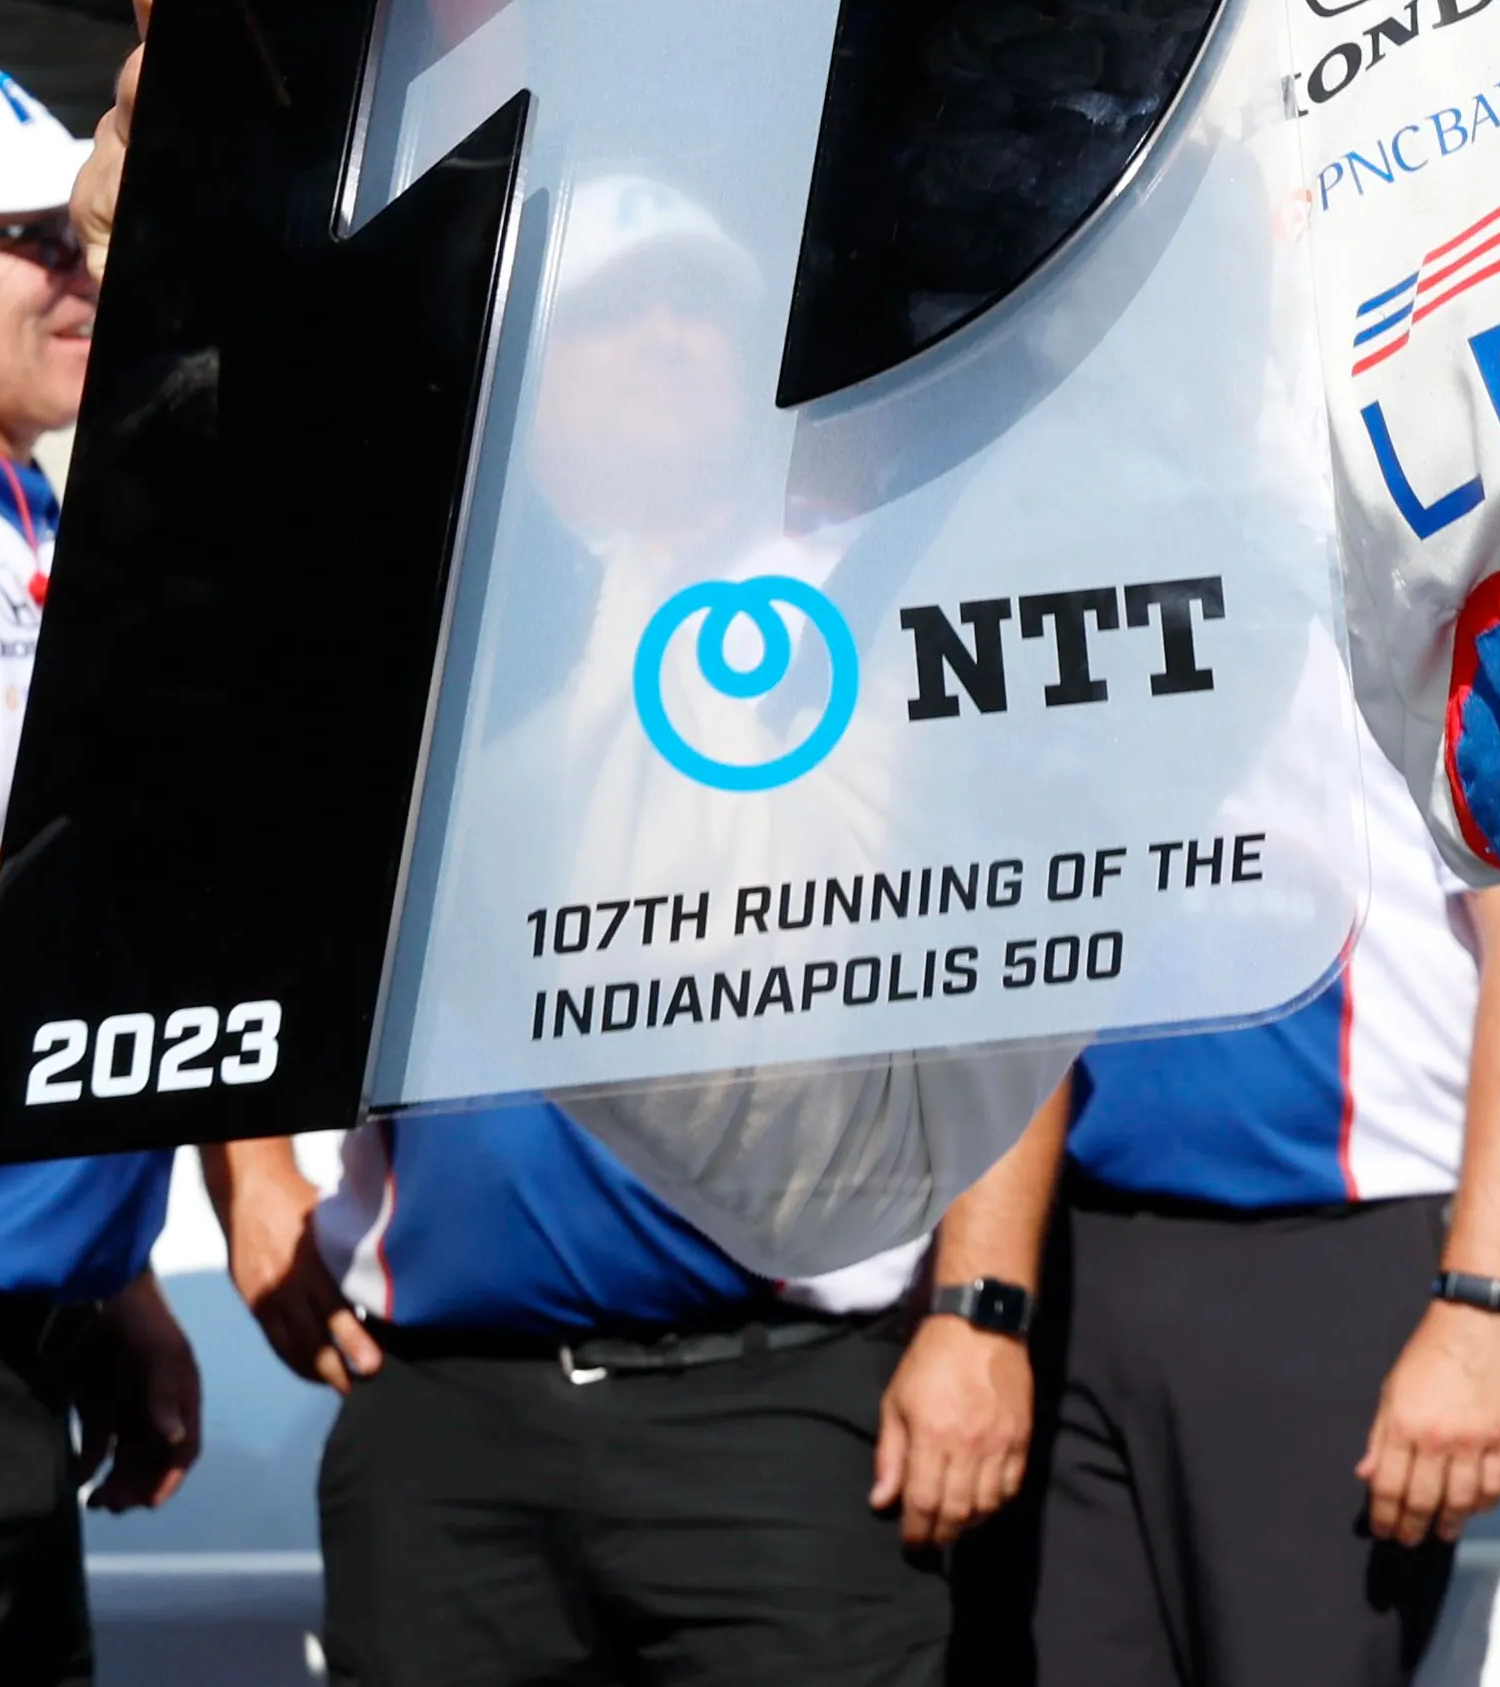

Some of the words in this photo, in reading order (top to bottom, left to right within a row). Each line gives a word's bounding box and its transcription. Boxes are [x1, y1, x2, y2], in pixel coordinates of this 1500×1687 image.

[901, 576, 1226, 720] NTT
[525, 893, 710, 957] 107TH
[735, 859, 1024, 937] RUNNING
[1046, 847, 1125, 902] OF
[1147, 831, 1266, 889] THE
[531, 946, 978, 1042] INDIANAPOLIS
[1000, 929, 1125, 987] 500
[25, 1001, 282, 1106] 2023
